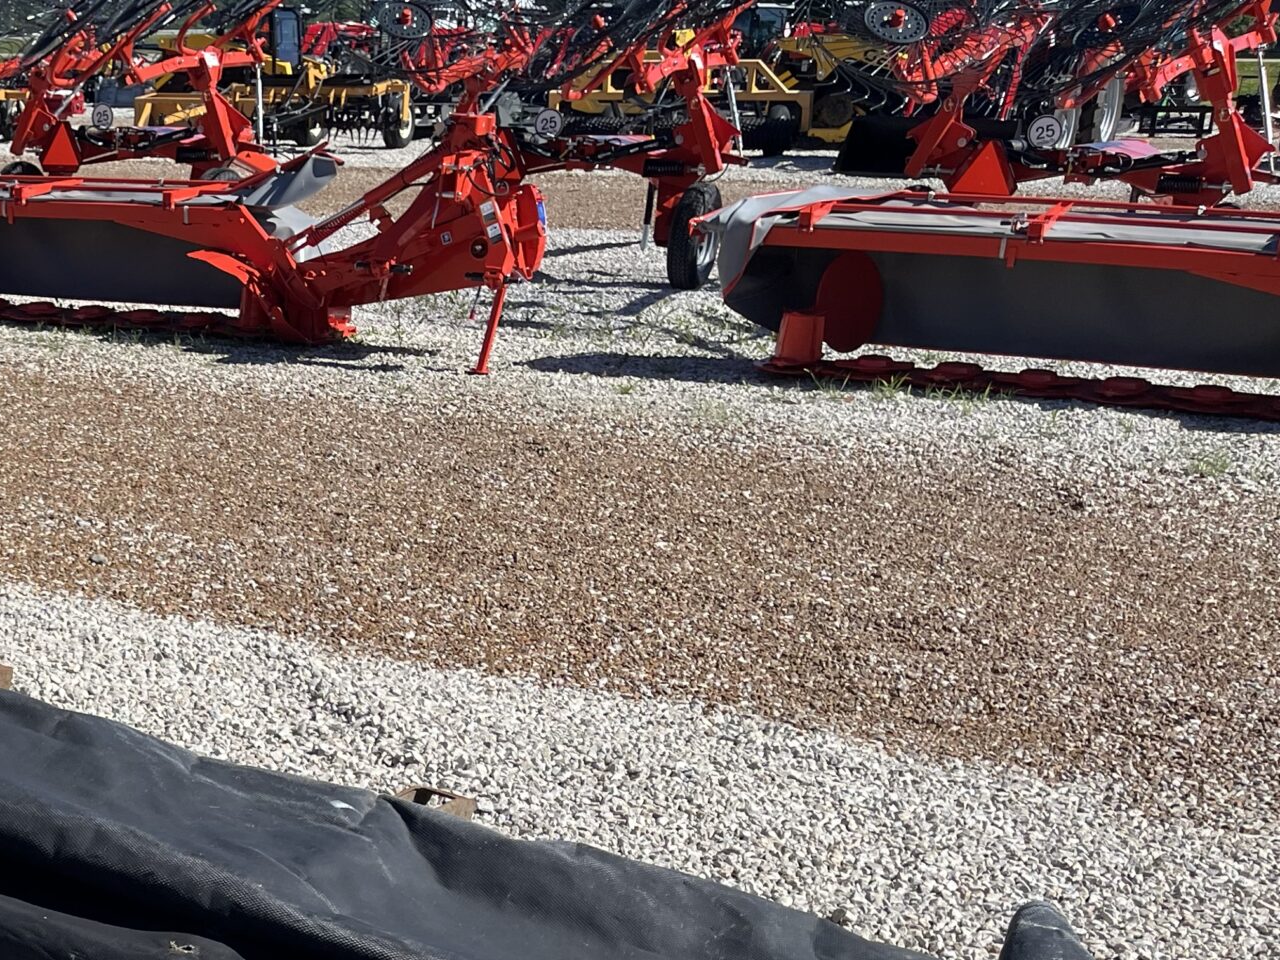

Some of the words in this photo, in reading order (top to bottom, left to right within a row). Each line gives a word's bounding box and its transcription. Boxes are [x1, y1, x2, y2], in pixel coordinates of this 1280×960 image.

[96, 110, 109, 123] 25
[540, 116, 557, 130] 25
[1035, 123, 1055, 140] 25
